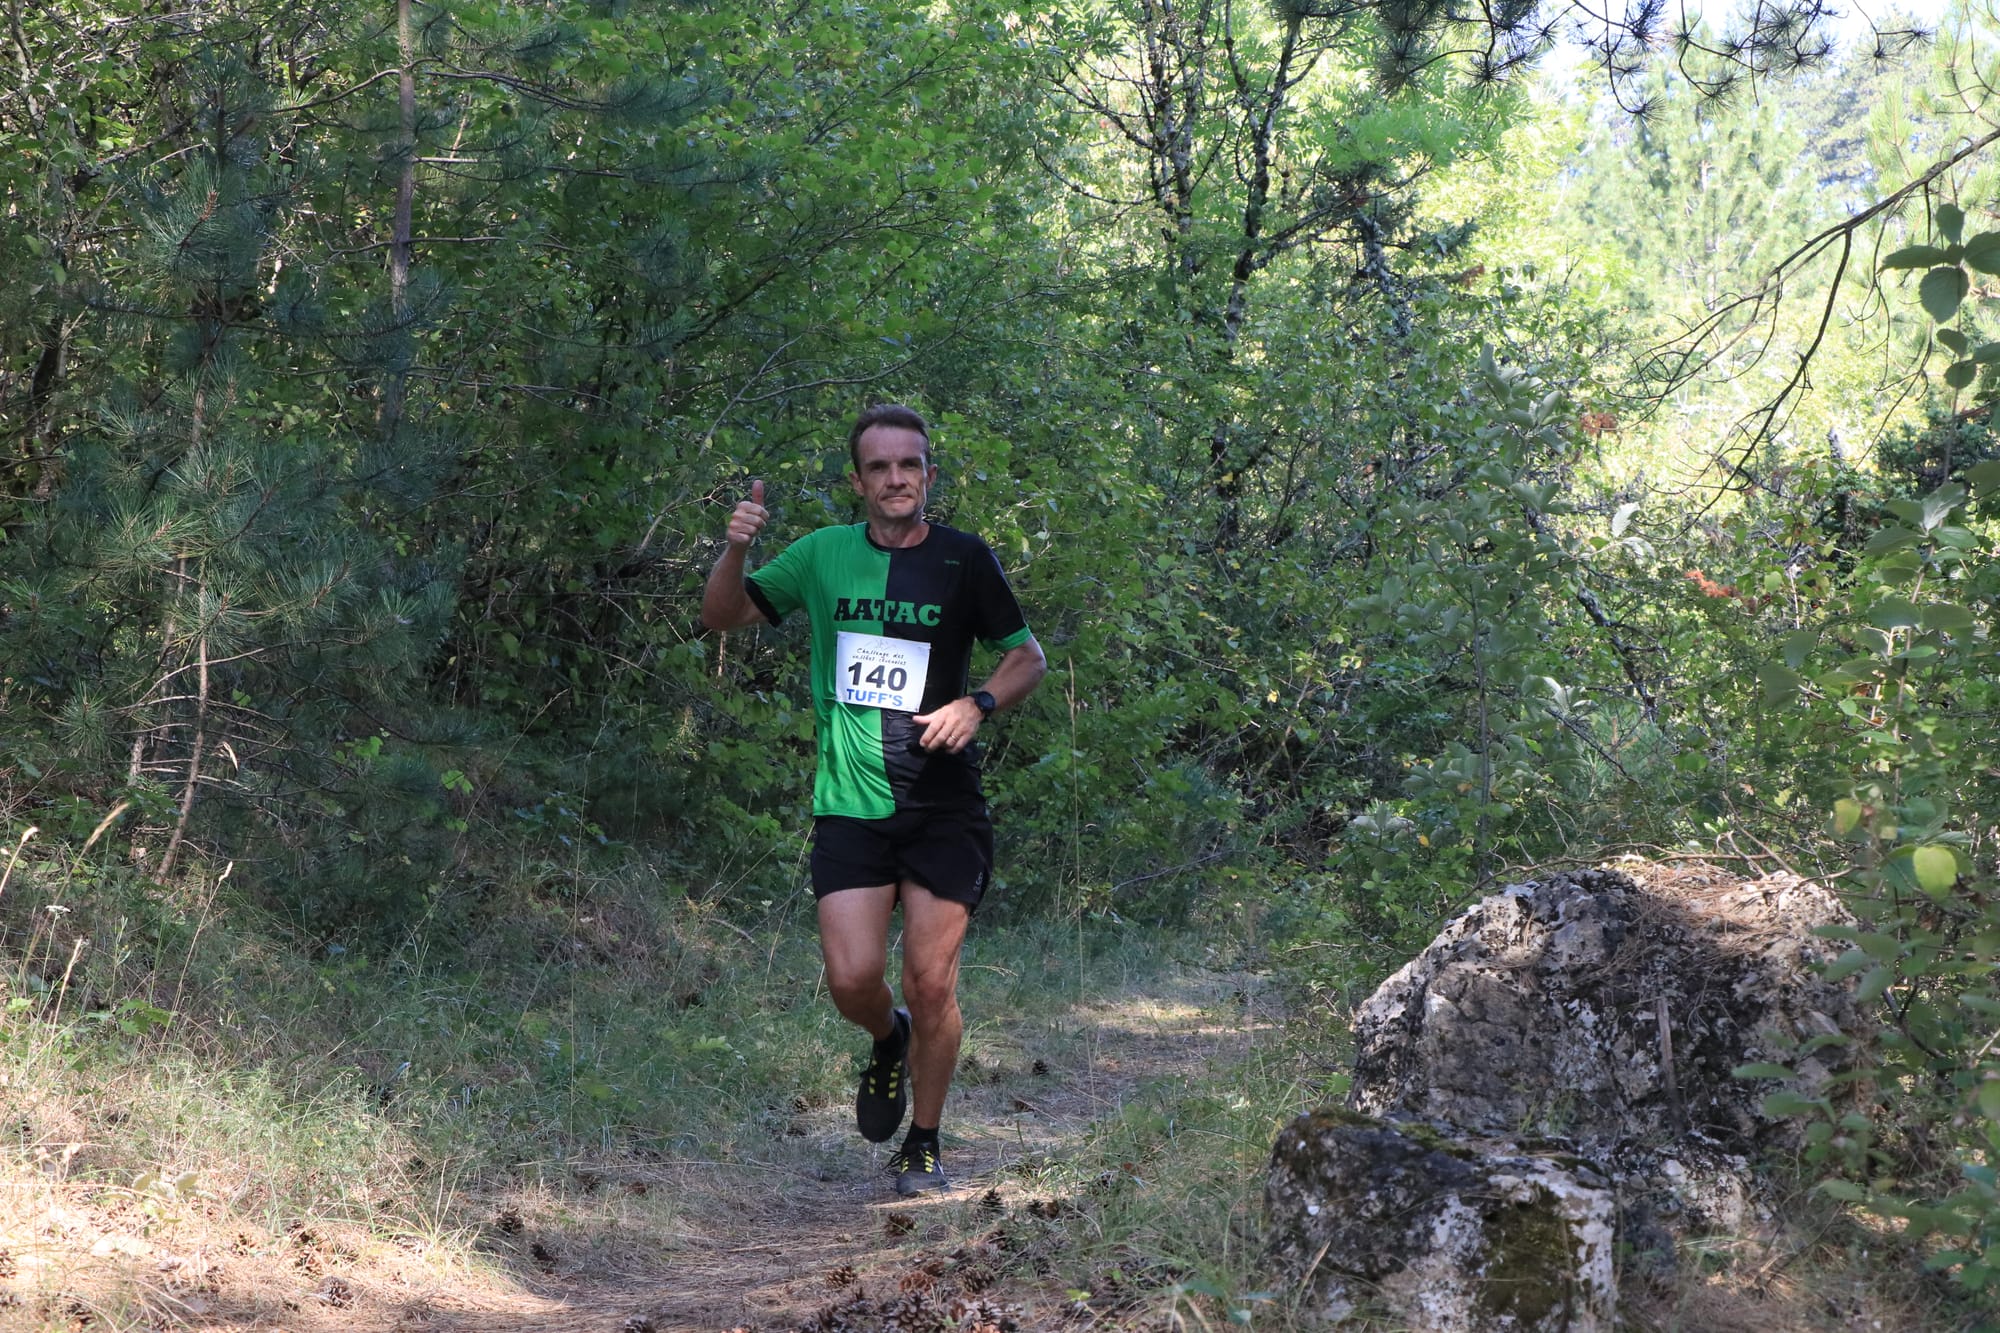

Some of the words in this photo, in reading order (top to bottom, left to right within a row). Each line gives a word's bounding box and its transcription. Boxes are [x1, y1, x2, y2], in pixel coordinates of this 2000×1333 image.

[834, 598, 942, 627] AATAC
[857, 648, 889, 658] Challenge
[848, 661, 907, 692] 140
[846, 688, 903, 707] TUFF'S
